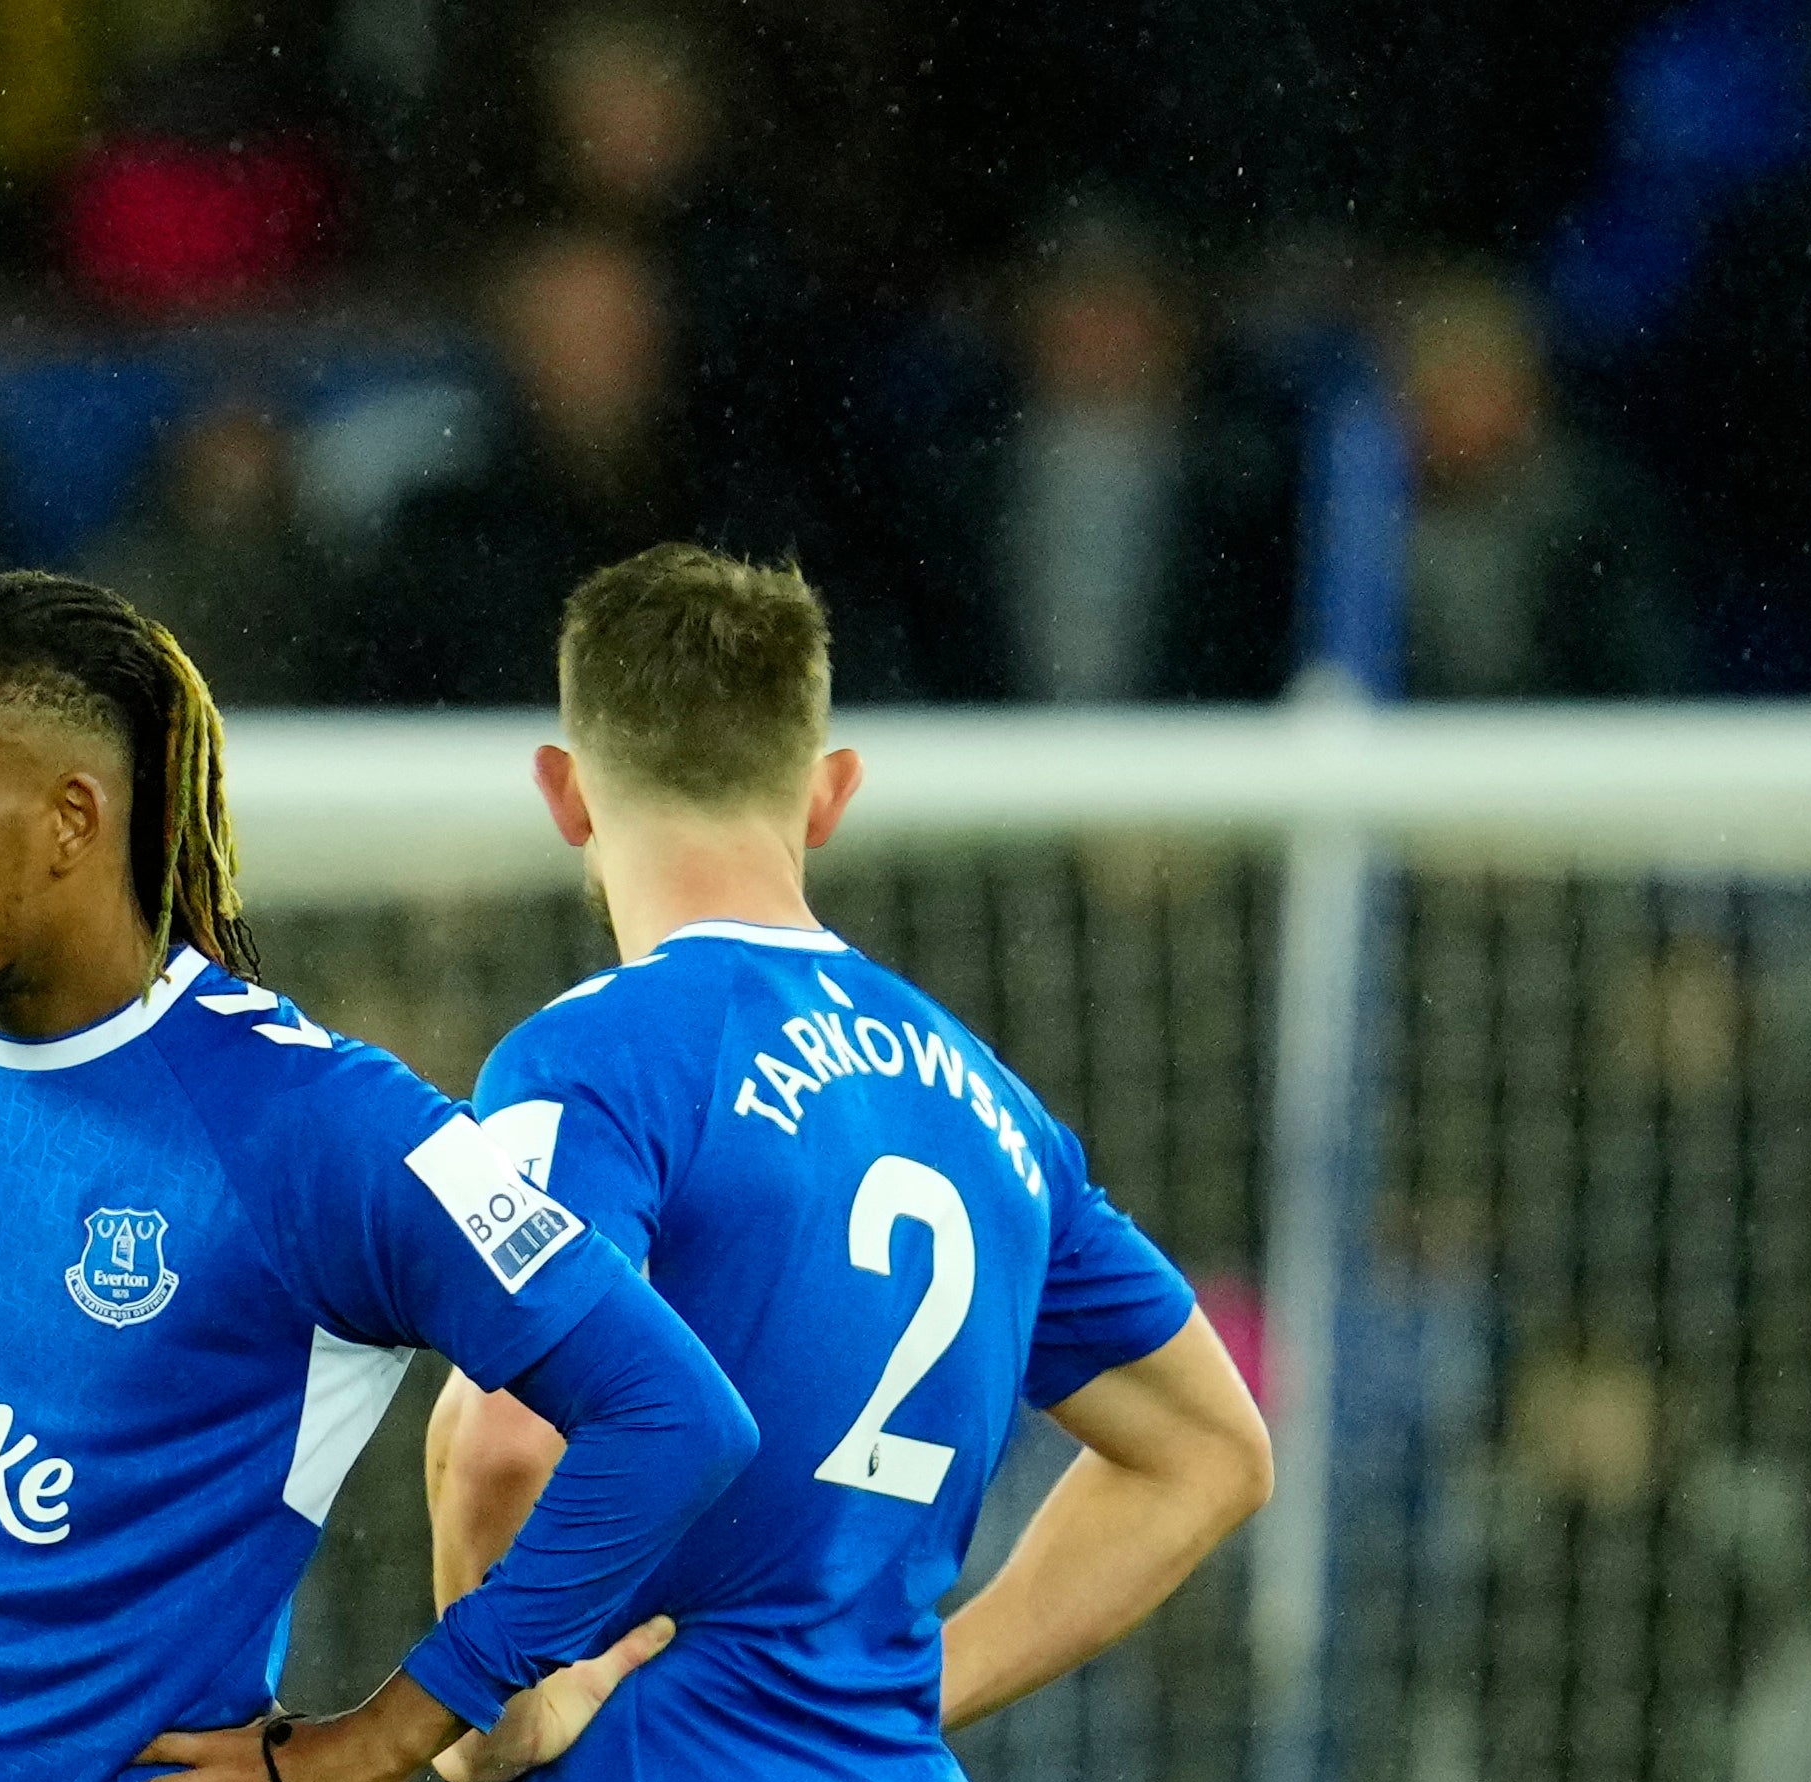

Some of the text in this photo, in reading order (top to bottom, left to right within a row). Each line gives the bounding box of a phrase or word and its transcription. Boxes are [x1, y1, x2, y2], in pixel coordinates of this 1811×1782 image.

[733, 1012, 1042, 1197] TARKOWSKI
[93, 1269, 149, 1288] Everton
[814, 1154, 976, 1504] 2
